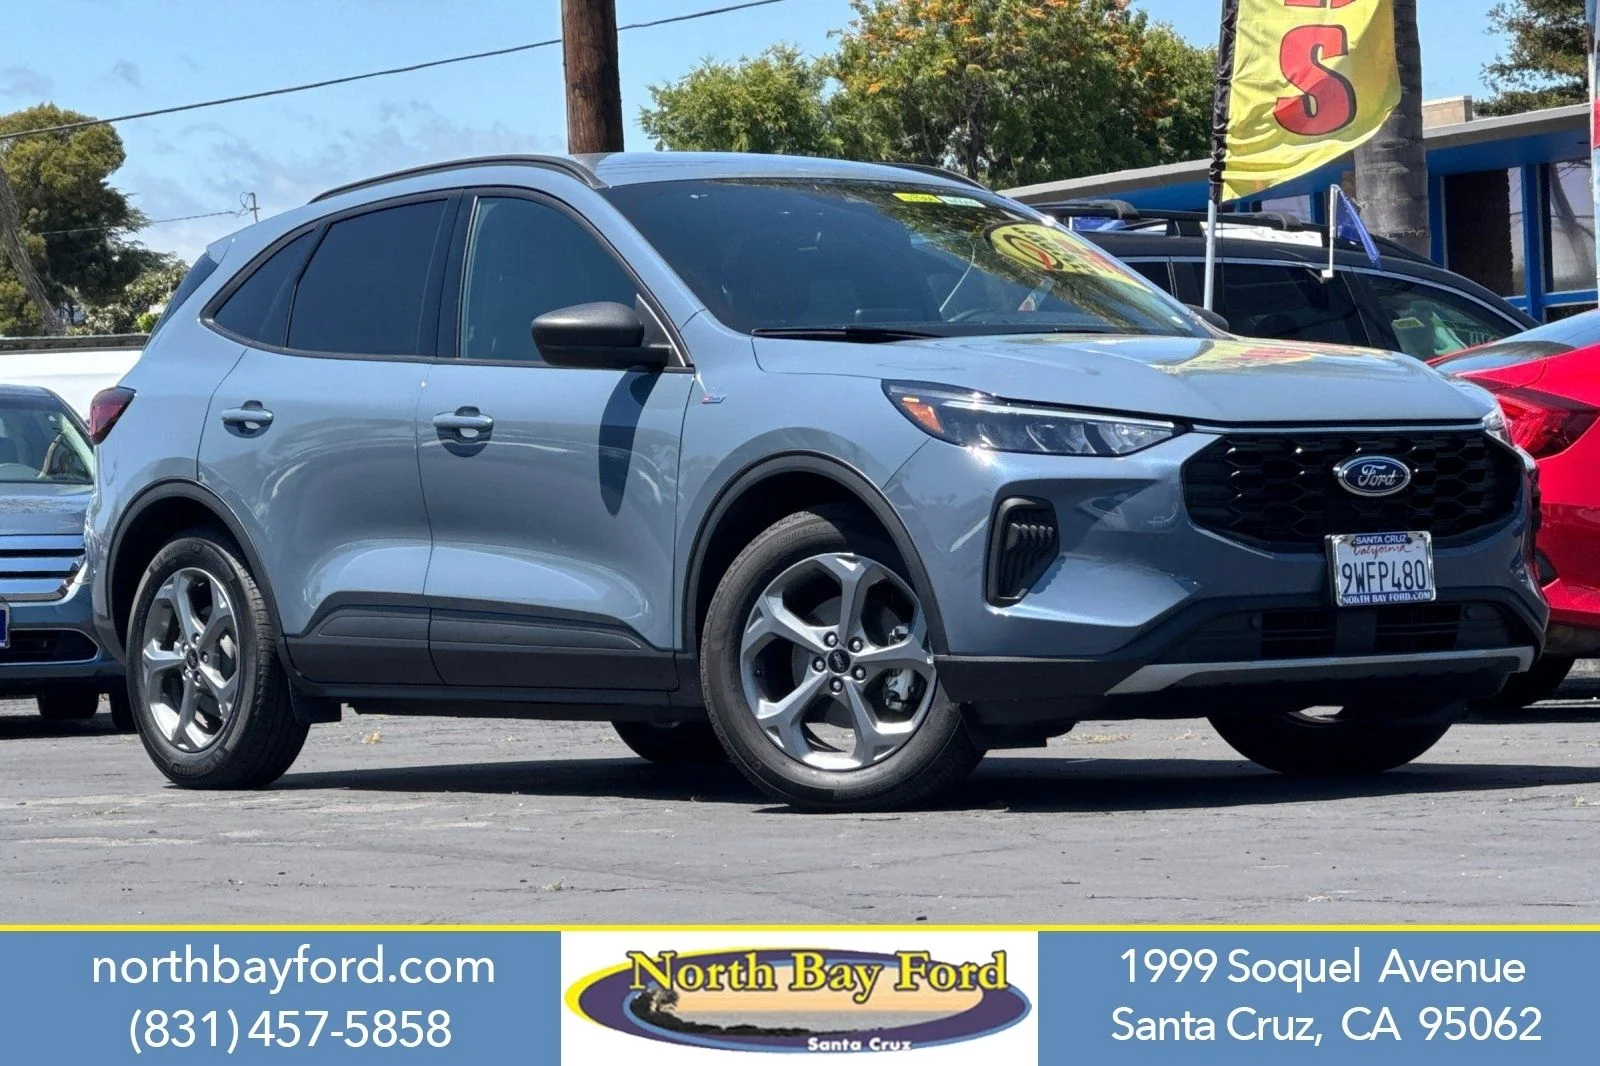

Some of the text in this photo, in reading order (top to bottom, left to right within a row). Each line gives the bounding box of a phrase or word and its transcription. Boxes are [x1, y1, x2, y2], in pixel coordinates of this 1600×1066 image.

[1274, 0, 1358, 136] S
[1357, 464, 1396, 486] Ford
[1355, 534, 1407, 545] SANTA CRUZ
[1354, 544, 1412, 559] California
[1341, 560, 1426, 594] 9WFP480
[1342, 594, 1371, 605] NORTH
[1371, 592, 1388, 603] BAY
